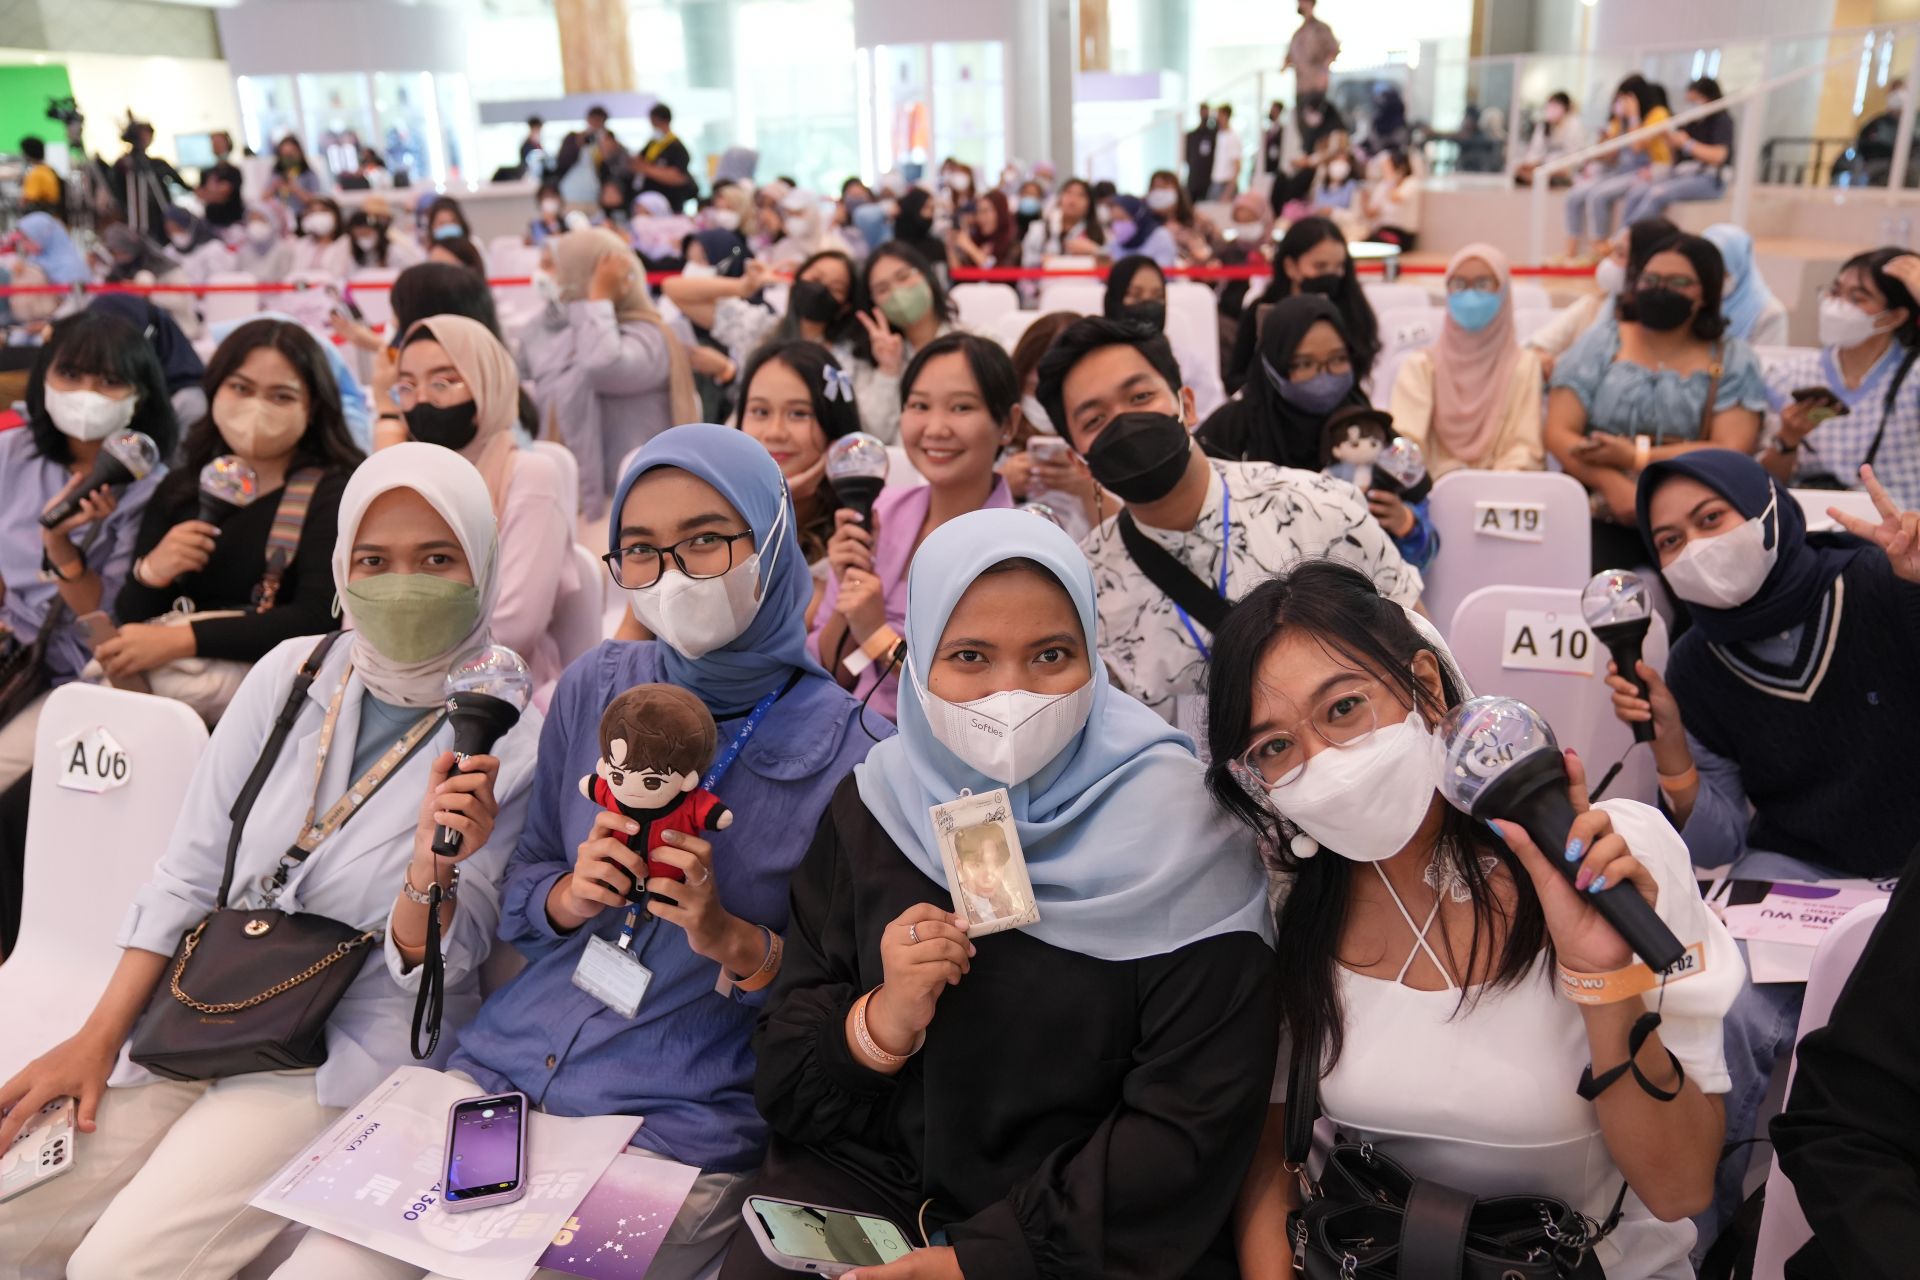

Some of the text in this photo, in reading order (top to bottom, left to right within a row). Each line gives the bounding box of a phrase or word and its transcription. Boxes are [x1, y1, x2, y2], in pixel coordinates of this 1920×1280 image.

[1481, 508, 1539, 531] A 19
[1511, 625, 1588, 660] A 10
[971, 718, 1003, 738] Softies
[68, 741, 127, 780] A 06
[1760, 909, 1793, 921] WU
[1581, 977, 1605, 989] WU
[345, 1122, 381, 1151] KOCCA
[403, 1194, 436, 1221] 360
